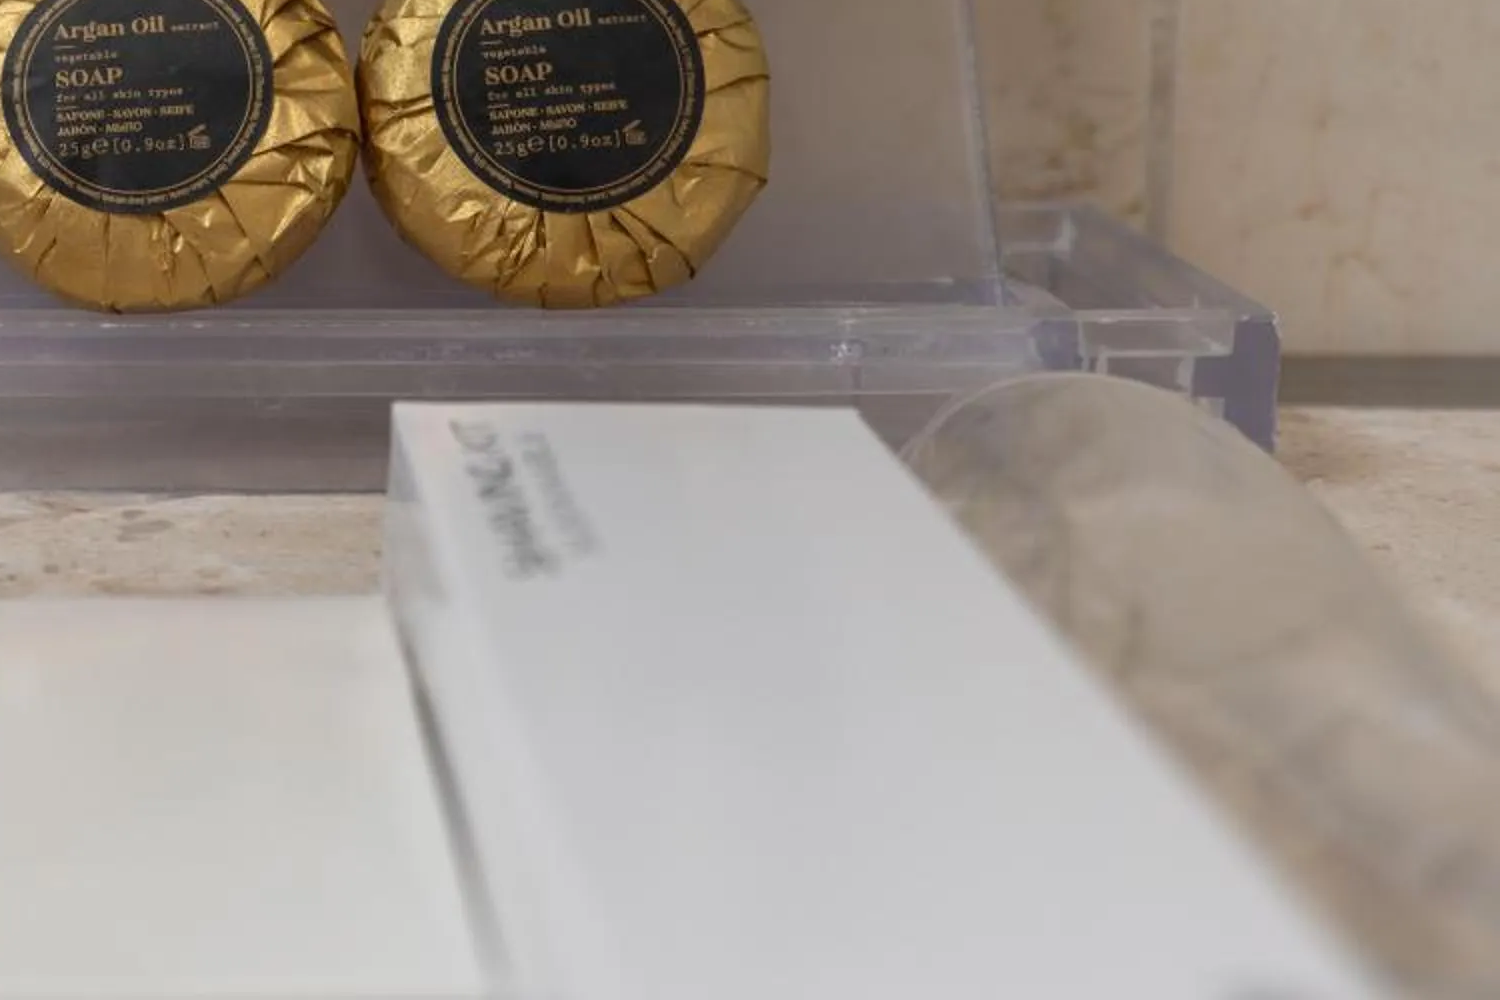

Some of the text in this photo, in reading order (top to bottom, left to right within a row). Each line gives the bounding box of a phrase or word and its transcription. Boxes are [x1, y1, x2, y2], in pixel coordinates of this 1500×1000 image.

[54, 20, 126, 43] Argan
[131, 15, 166, 34] Oil
[480, 15, 552, 37] Argan
[557, 7, 592, 28] Oil
[55, 67, 123, 88] SOAP
[484, 62, 553, 85] SOAP
